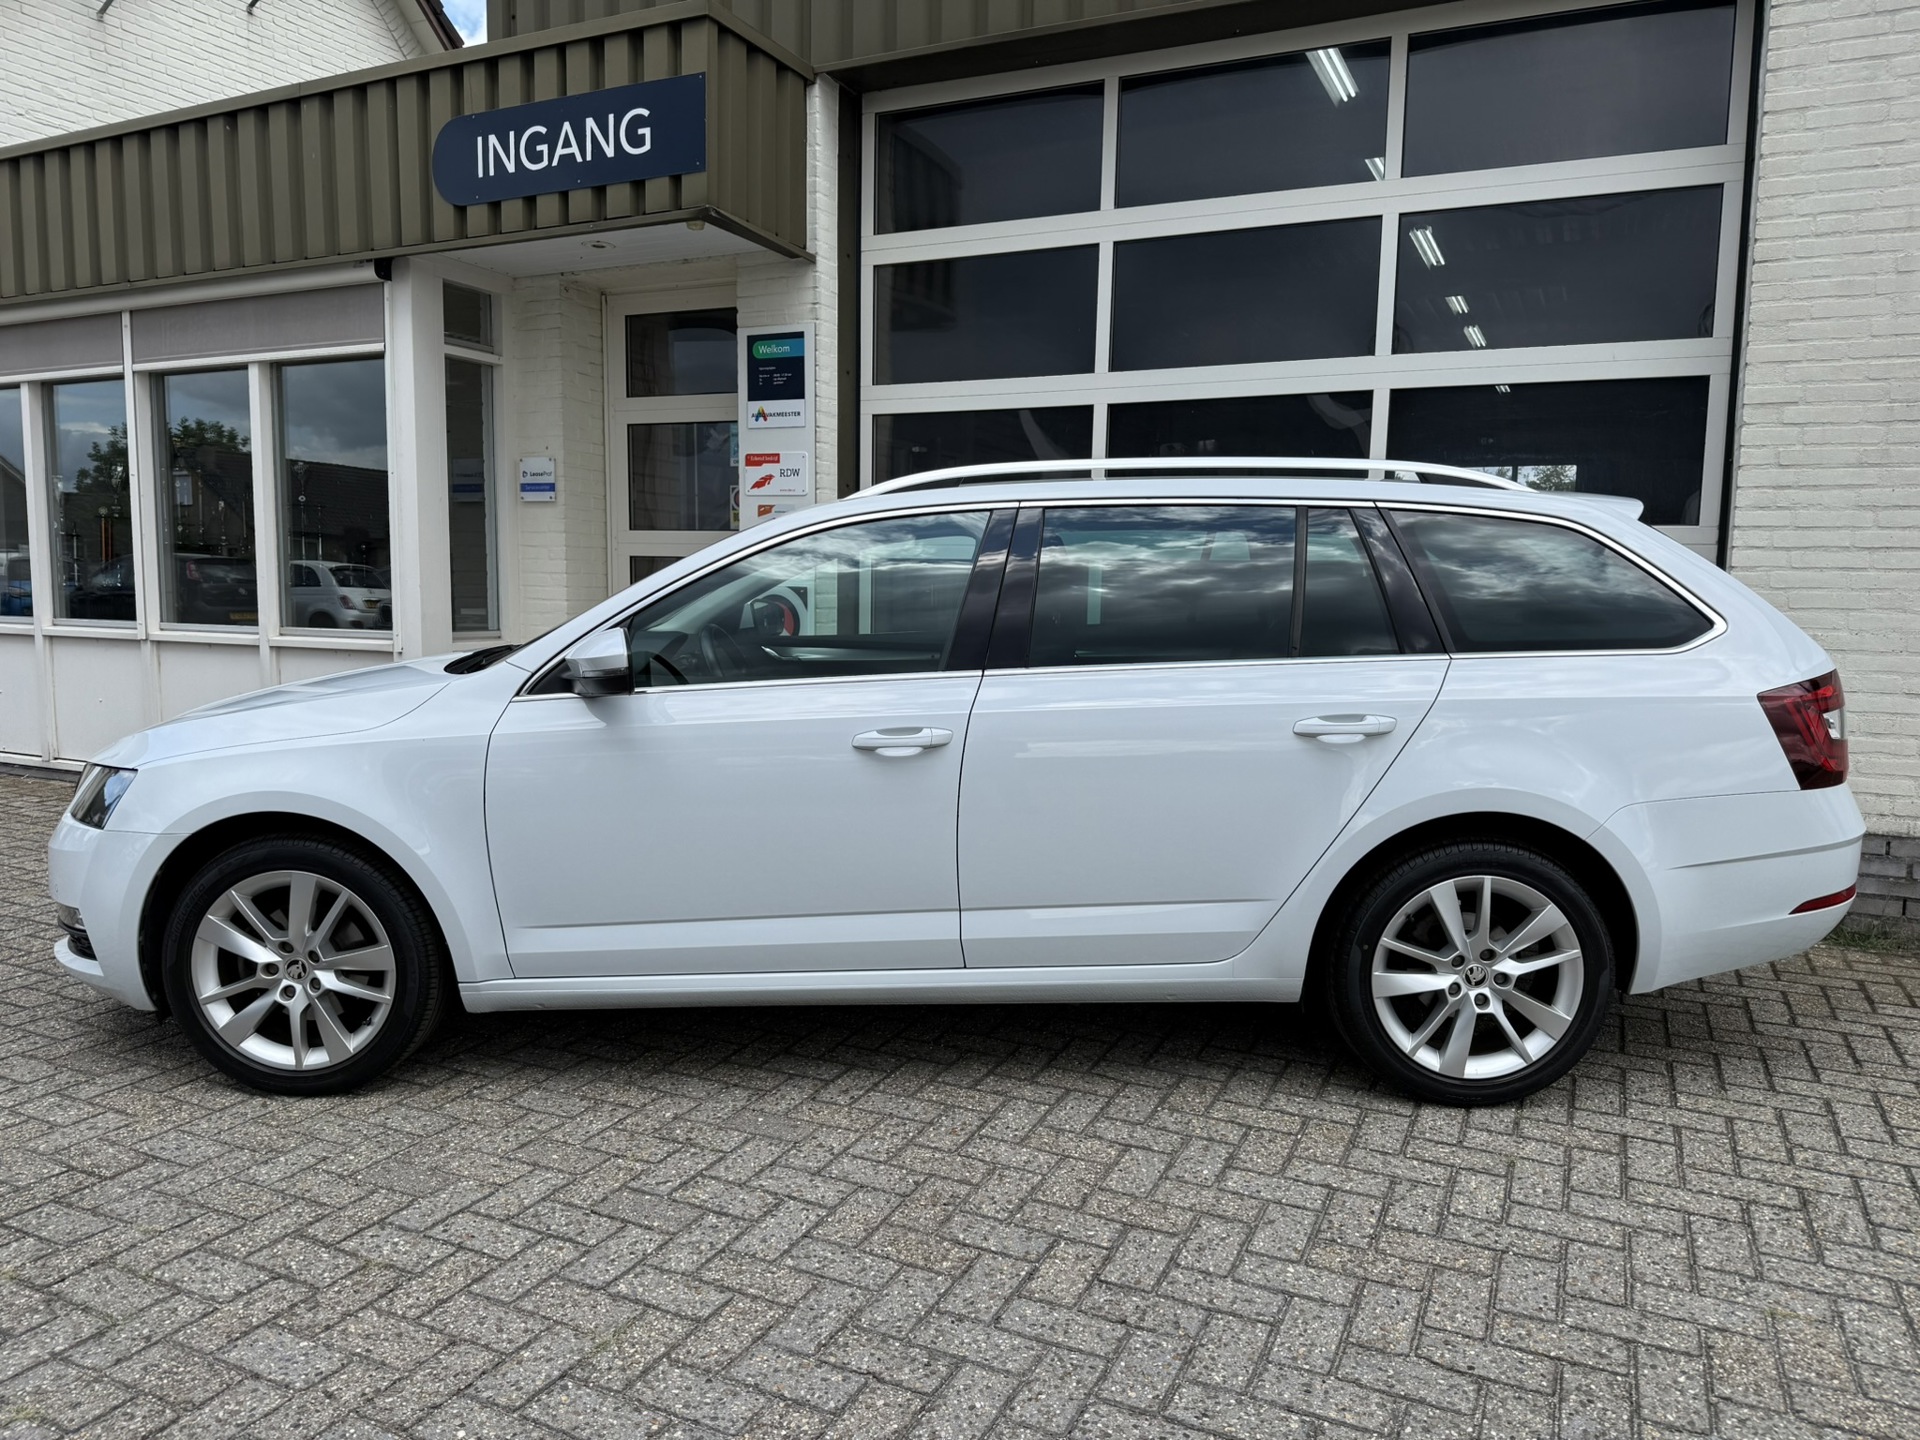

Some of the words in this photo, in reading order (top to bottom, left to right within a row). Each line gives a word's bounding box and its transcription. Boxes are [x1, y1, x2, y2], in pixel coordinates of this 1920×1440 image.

[477, 107, 651, 178] INGANG
[758, 344, 790, 354] Welkom
[779, 468, 800, 478] RDW
